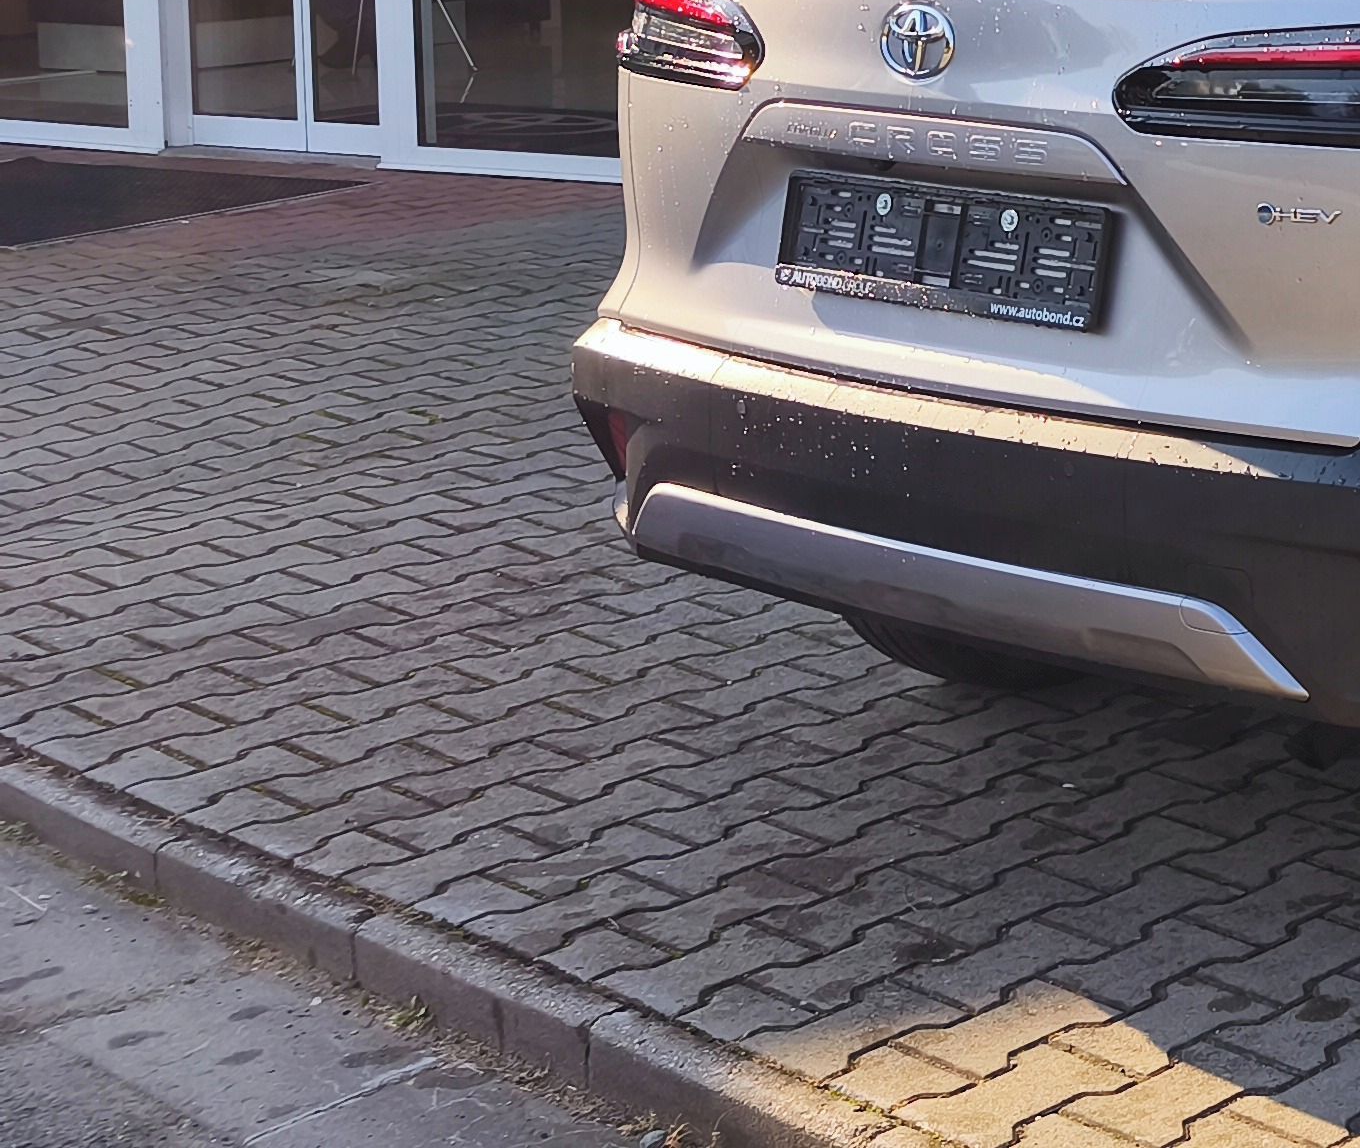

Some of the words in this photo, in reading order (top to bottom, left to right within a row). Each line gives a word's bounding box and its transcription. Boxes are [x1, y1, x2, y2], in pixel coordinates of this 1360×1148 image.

[848, 121, 1048, 165] CROSS
[788, 270, 842, 290] AUTOBOND
[990, 302, 1085, 327] www.autobond.cz
